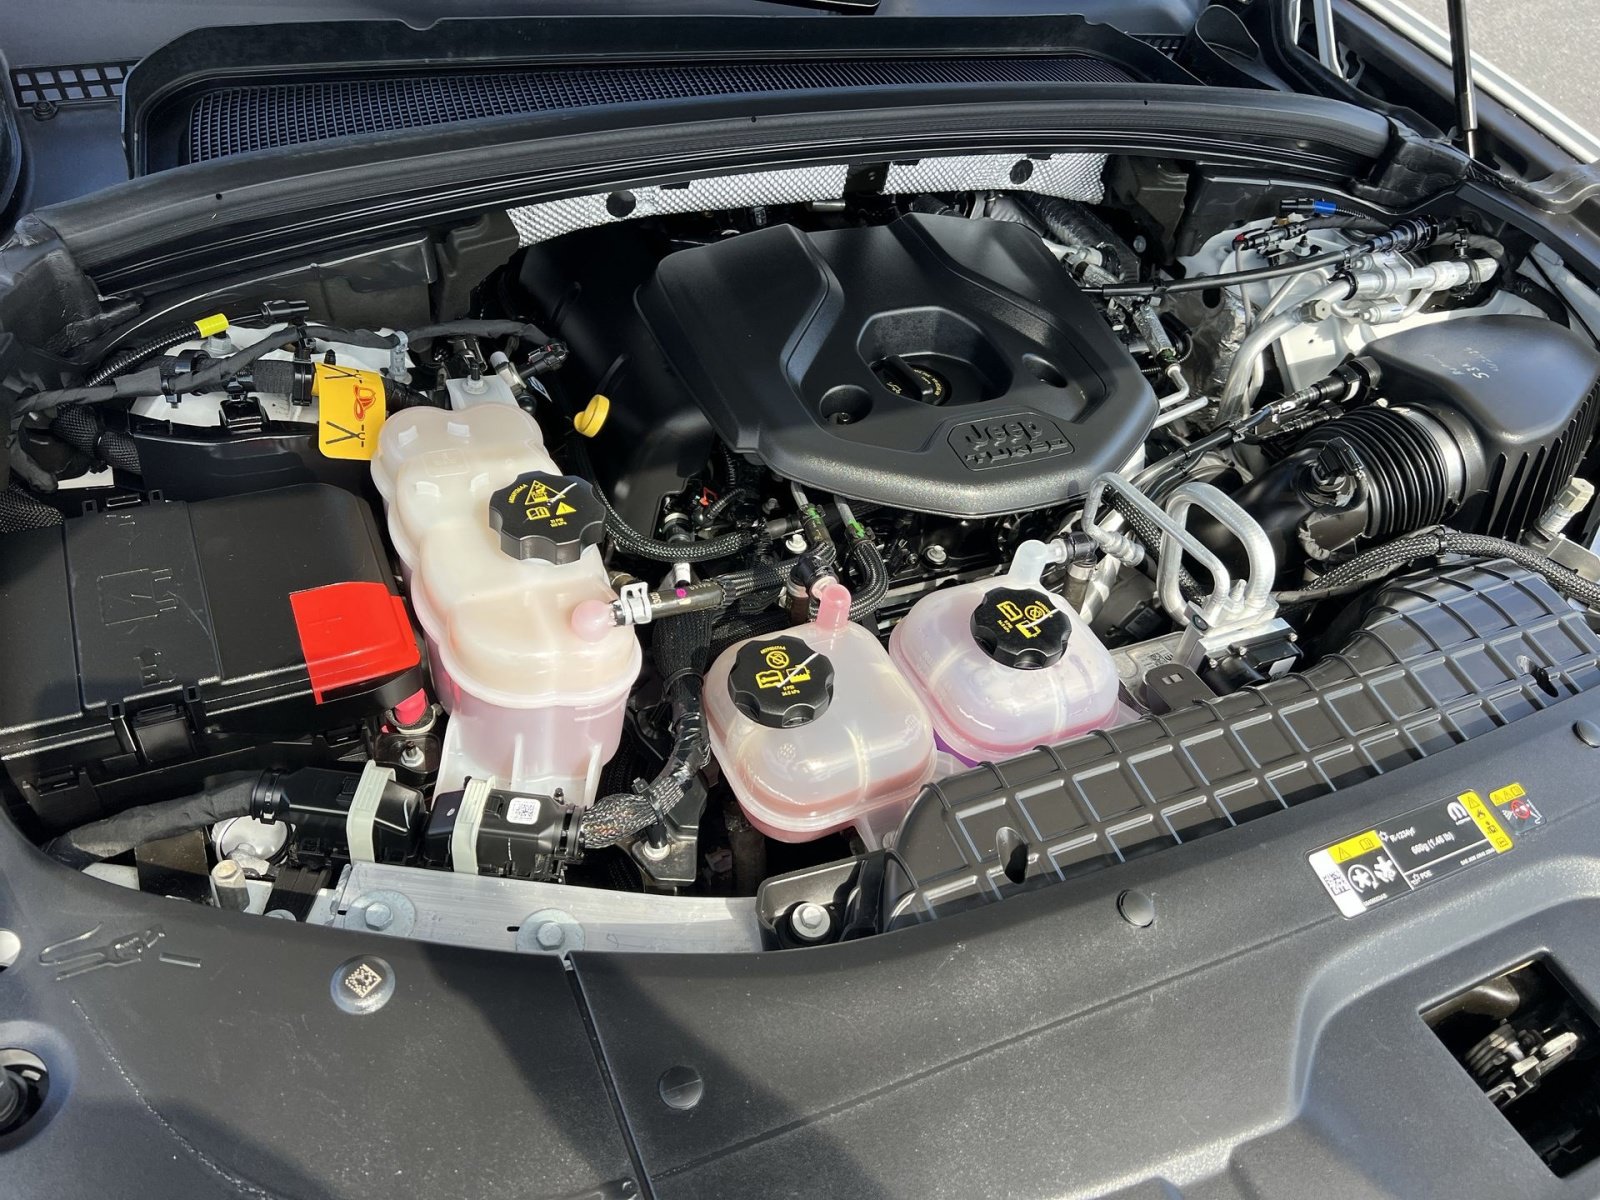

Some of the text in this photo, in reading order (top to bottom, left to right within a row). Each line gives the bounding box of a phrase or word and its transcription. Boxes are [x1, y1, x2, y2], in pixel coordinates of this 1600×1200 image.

[965, 421, 1043, 451] Jeep
[965, 438, 1068, 464] TURBO
[1390, 826, 1416, 843] R-1234yf
[1420, 870, 1433, 879] POE
